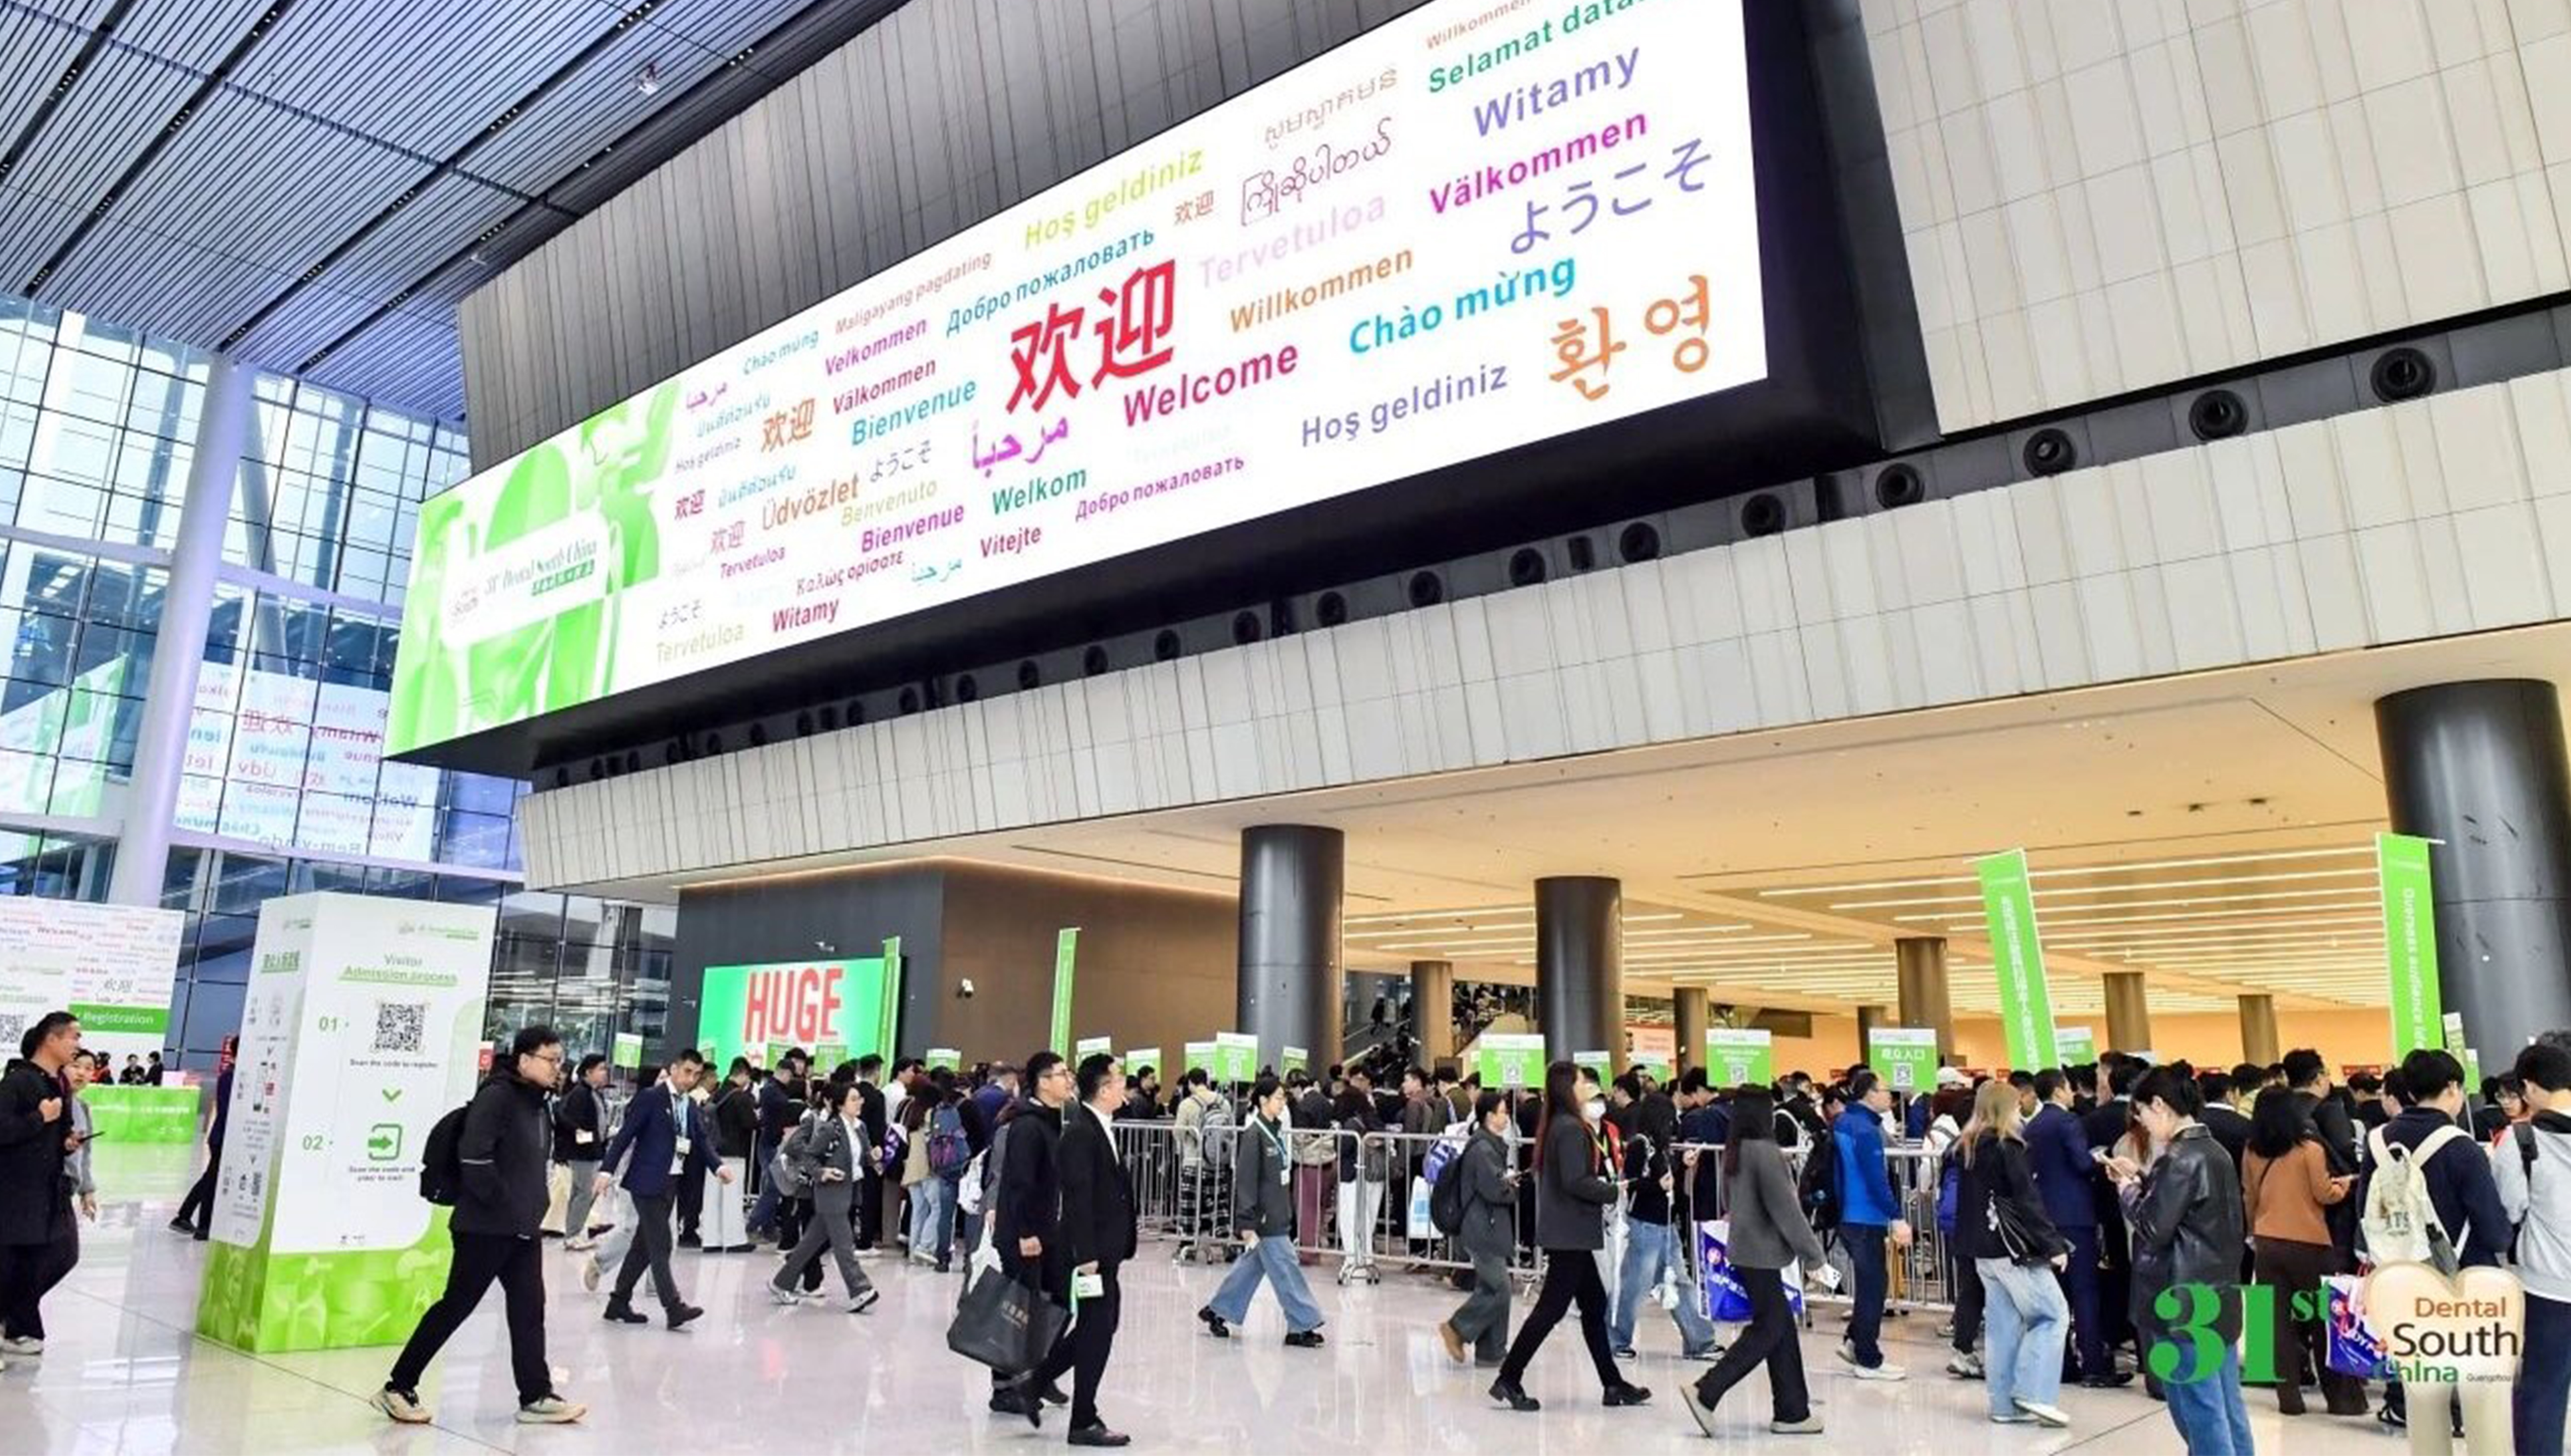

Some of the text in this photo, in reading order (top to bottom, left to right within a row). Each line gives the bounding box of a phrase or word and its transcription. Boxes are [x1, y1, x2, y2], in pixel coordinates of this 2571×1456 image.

[1429, 20, 1552, 93] Selamat
[1473, 47, 1640, 137] Witamy
[1429, 112, 1647, 215] Välkommen
[1510, 138, 1712, 254] ようこそ
[1025, 149, 1204, 248] Hoş geldiniz
[1174, 190, 1214, 225] 欢迎
[1200, 196, 1386, 289] Tervetuloa
[946, 228, 1154, 338] Добро пожаловать
[1229, 248, 1414, 335] Willkommen
[1349, 257, 1577, 356] Chào mừng
[825, 318, 927, 376] Velkommen
[1006, 258, 1176, 414] 欢迎
[832, 360, 936, 415] Välkommen
[850, 380, 977, 447] Bienvenue
[1124, 345, 1298, 427] Welcome
[1301, 363, 1508, 448] Hoş geldiniz
[761, 397, 815, 453] 欢迎
[869, 440, 931, 483] ようこそ
[992, 469, 1087, 515] Welkom
[1075, 456, 1244, 522] Добро пожаловать
[762, 472, 860, 531] Üdvözlet
[840, 481, 938, 527] Benvenuto
[861, 504, 965, 553] Bienvenue
[657, 624, 745, 663] Tervetuloa
[772, 599, 839, 633] Witamy
[2403, 887, 2418, 952] Overseas
[319, 1017, 338, 1031] 01
[744, 967, 843, 1043] HUGE
[302, 1135, 323, 1151] 02
